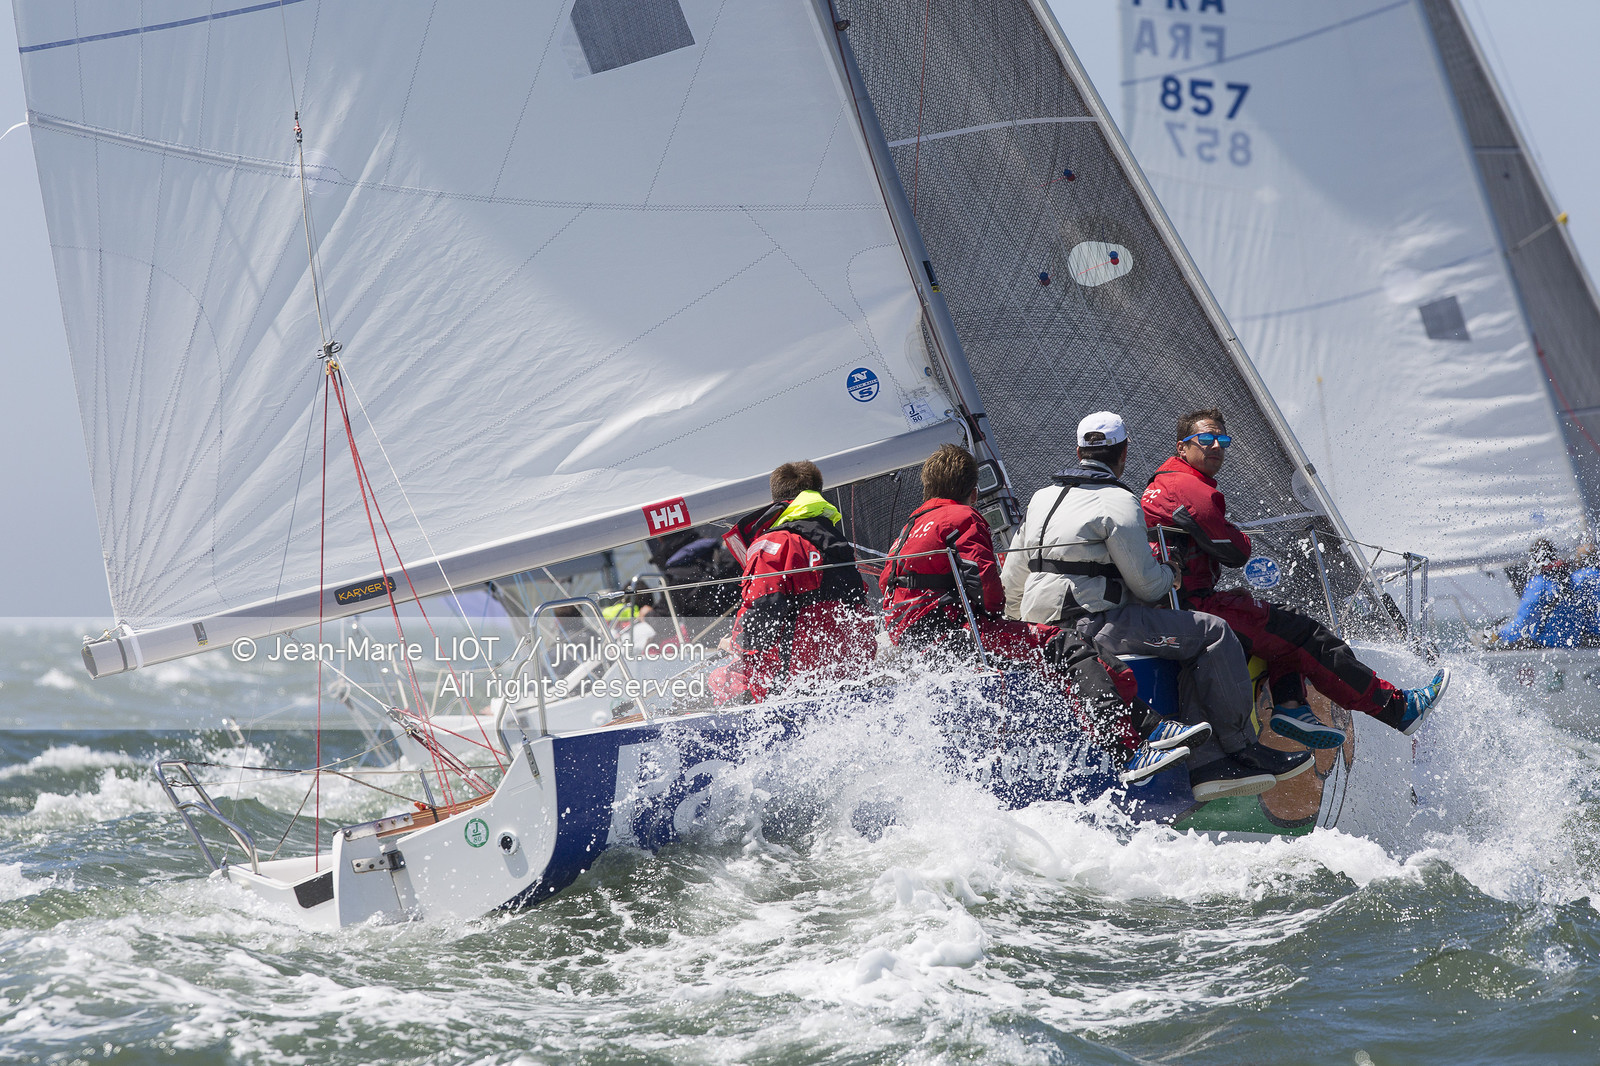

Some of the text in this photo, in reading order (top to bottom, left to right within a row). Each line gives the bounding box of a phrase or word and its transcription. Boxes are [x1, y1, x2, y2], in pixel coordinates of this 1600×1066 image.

[1160, 74, 1251, 120] 857
[650, 504, 685, 530] HH
[338, 582, 383, 601] KARVER
